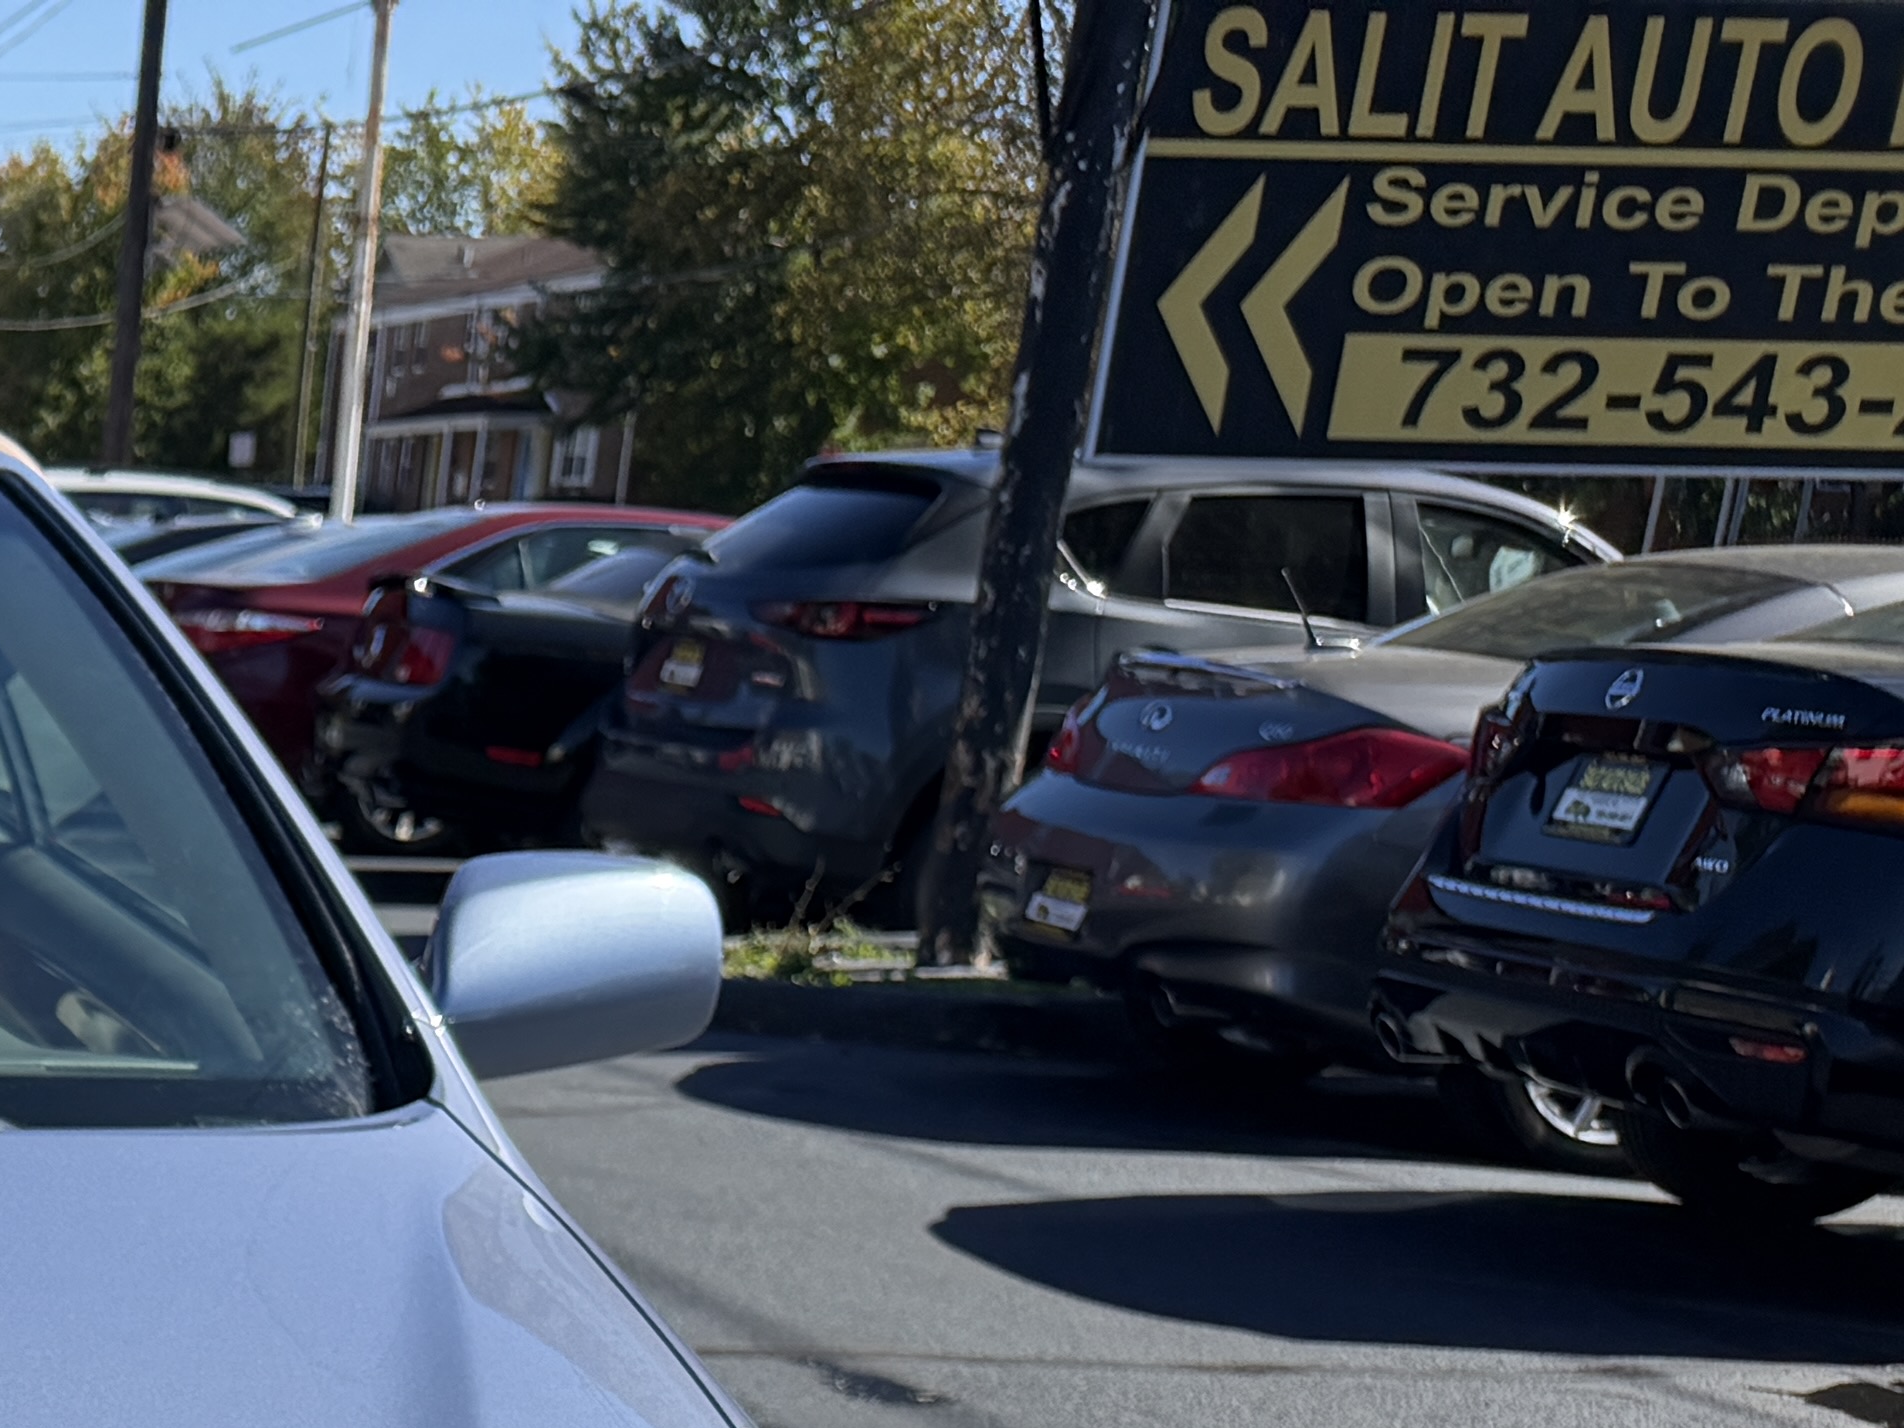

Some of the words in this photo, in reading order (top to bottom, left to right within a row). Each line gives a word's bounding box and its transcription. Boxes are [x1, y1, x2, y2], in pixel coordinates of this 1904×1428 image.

[1193, 6, 1528, 138] SALIT
[1535, 14, 1864, 146] AUTO
[1365, 167, 1705, 232] Service
[1352, 256, 1591, 329] Open
[1629, 260, 1732, 321] To
[1399, 347, 1904, 435] 732-543-
[1761, 706, 1846, 729] PLATINUM
